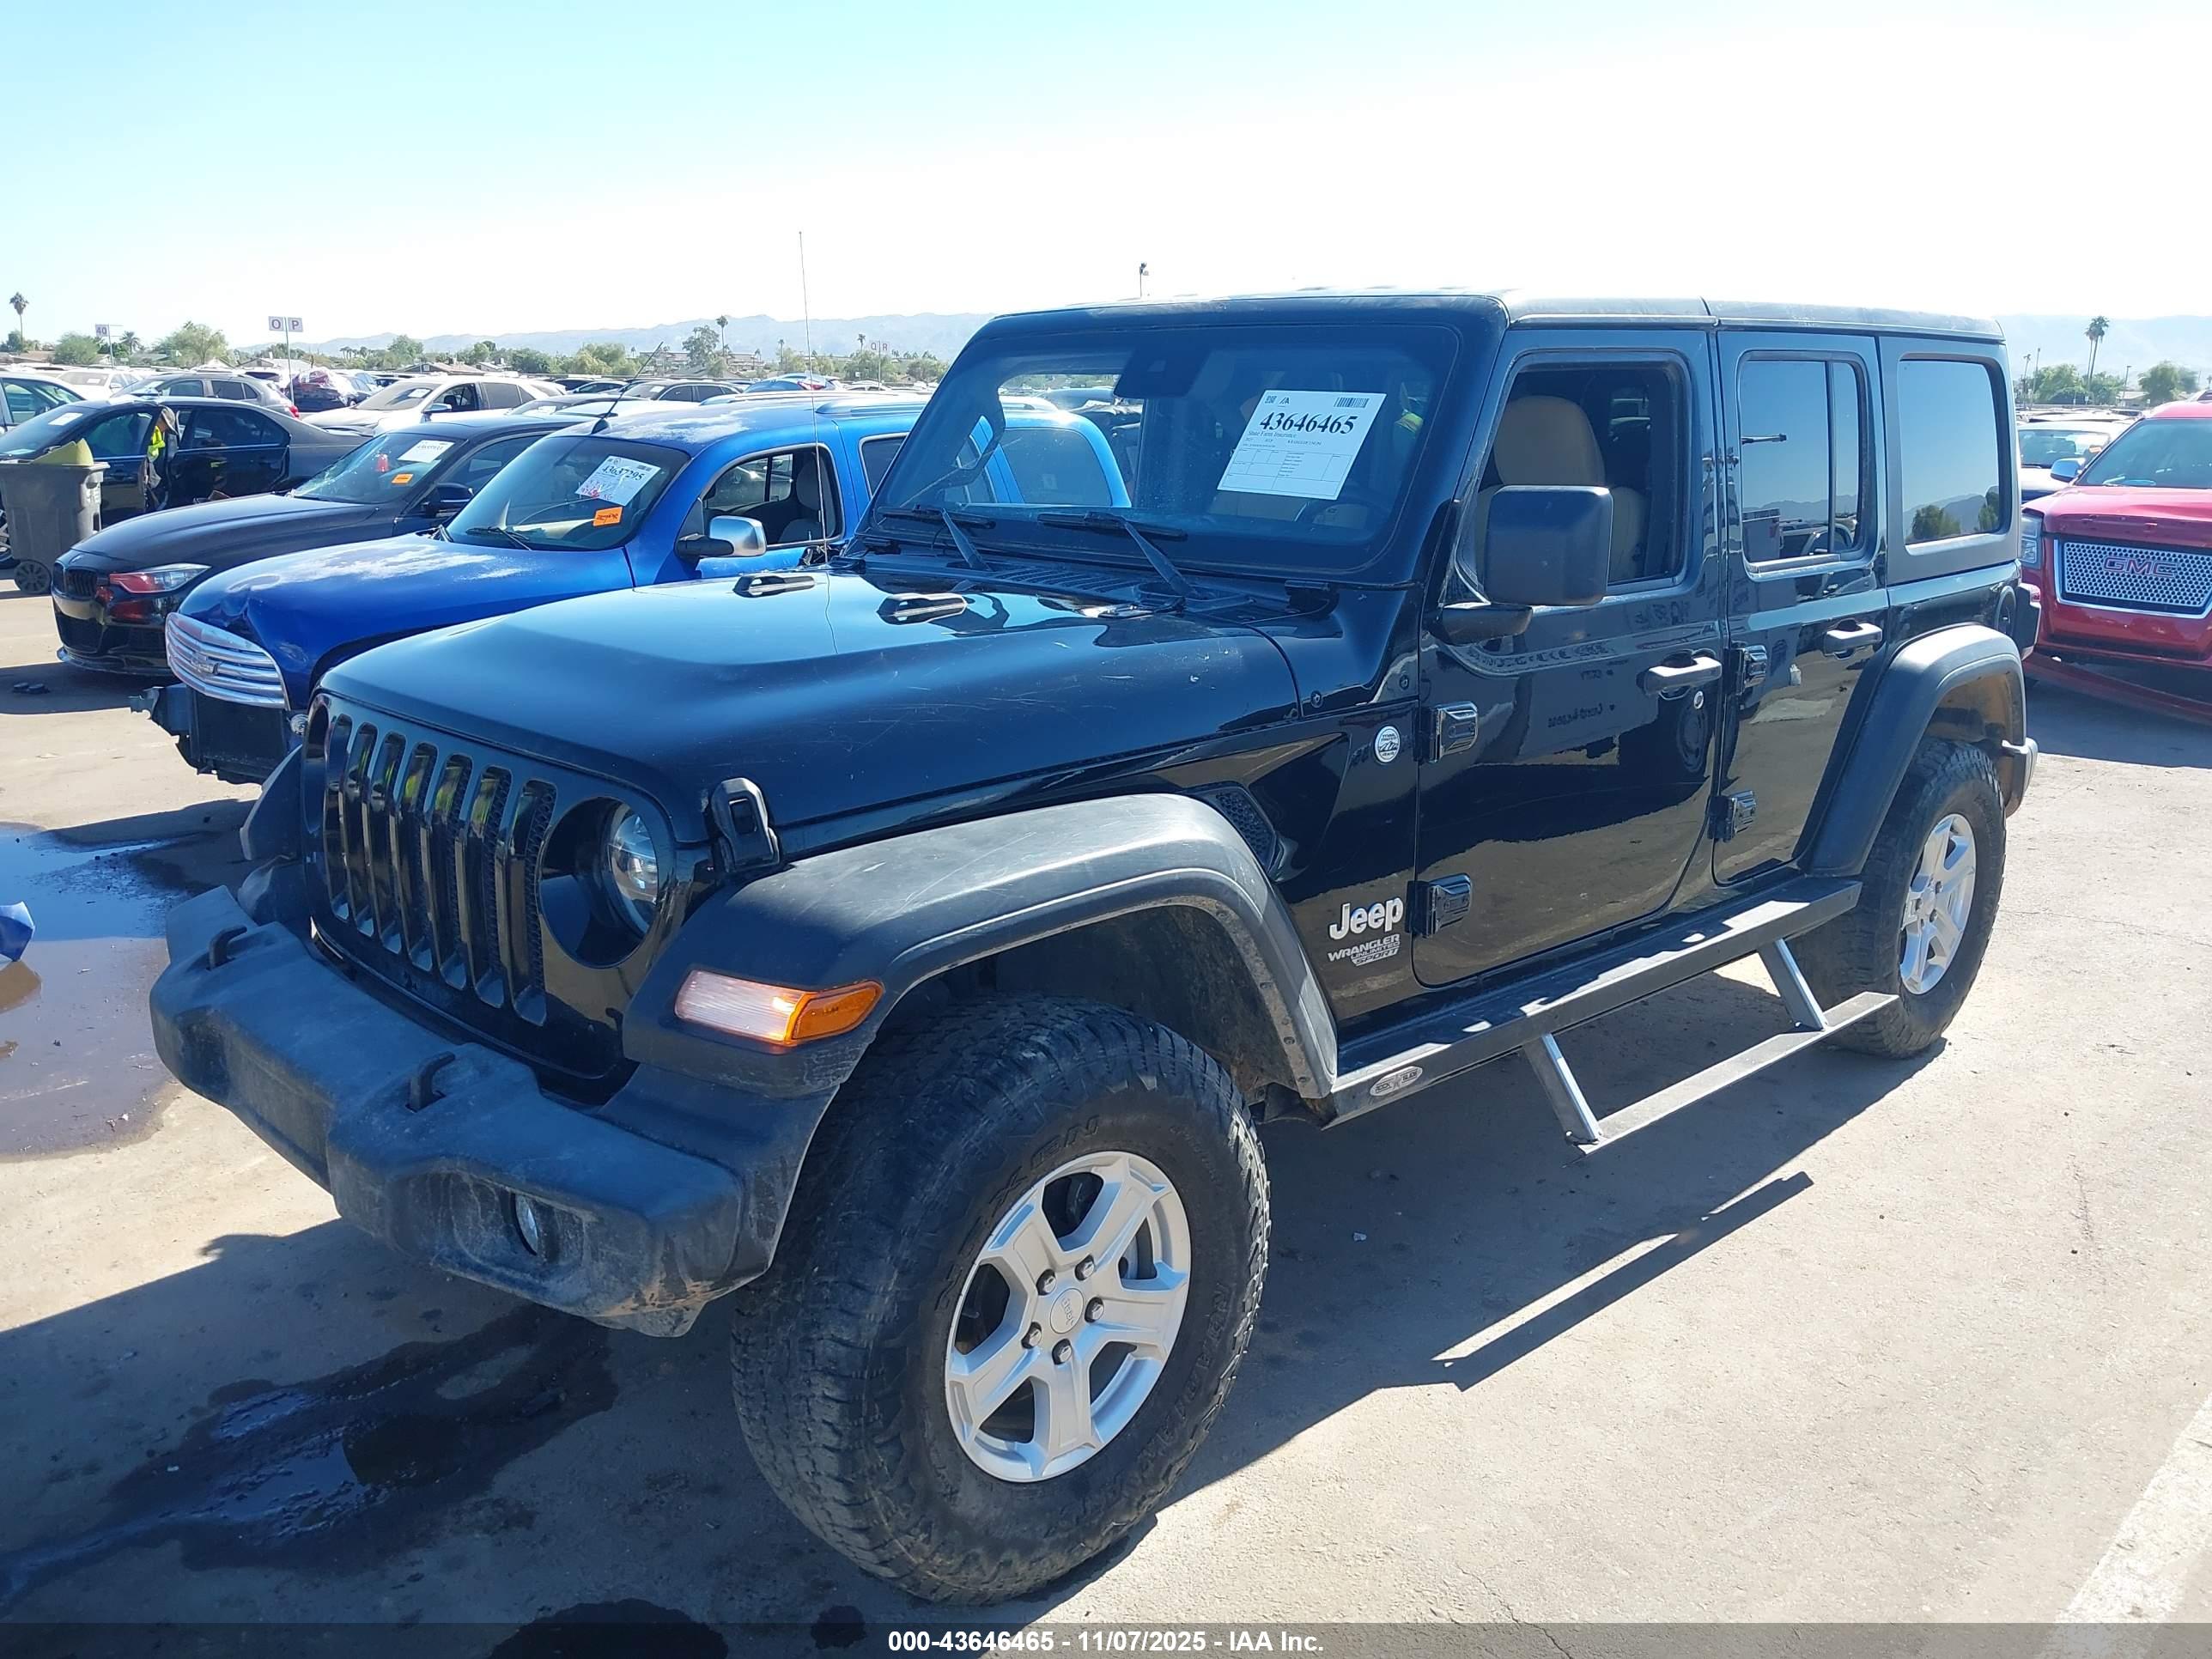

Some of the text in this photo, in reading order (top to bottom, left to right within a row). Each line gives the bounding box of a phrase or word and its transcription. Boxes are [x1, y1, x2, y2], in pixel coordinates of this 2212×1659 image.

[96, 326, 107, 336] 40
[271, 319, 282, 330] O
[291, 319, 300, 331] P
[882, 343, 888, 351] R
[1260, 411, 1359, 434] 43646465
[602, 465, 646, 481] 43637295
[2102, 556, 2177, 579] GMC
[1328, 897, 1404, 940] Jeep
[1328, 933, 1401, 962] WRANGLER
[1351, 941, 1401, 959] UNLIMITED
